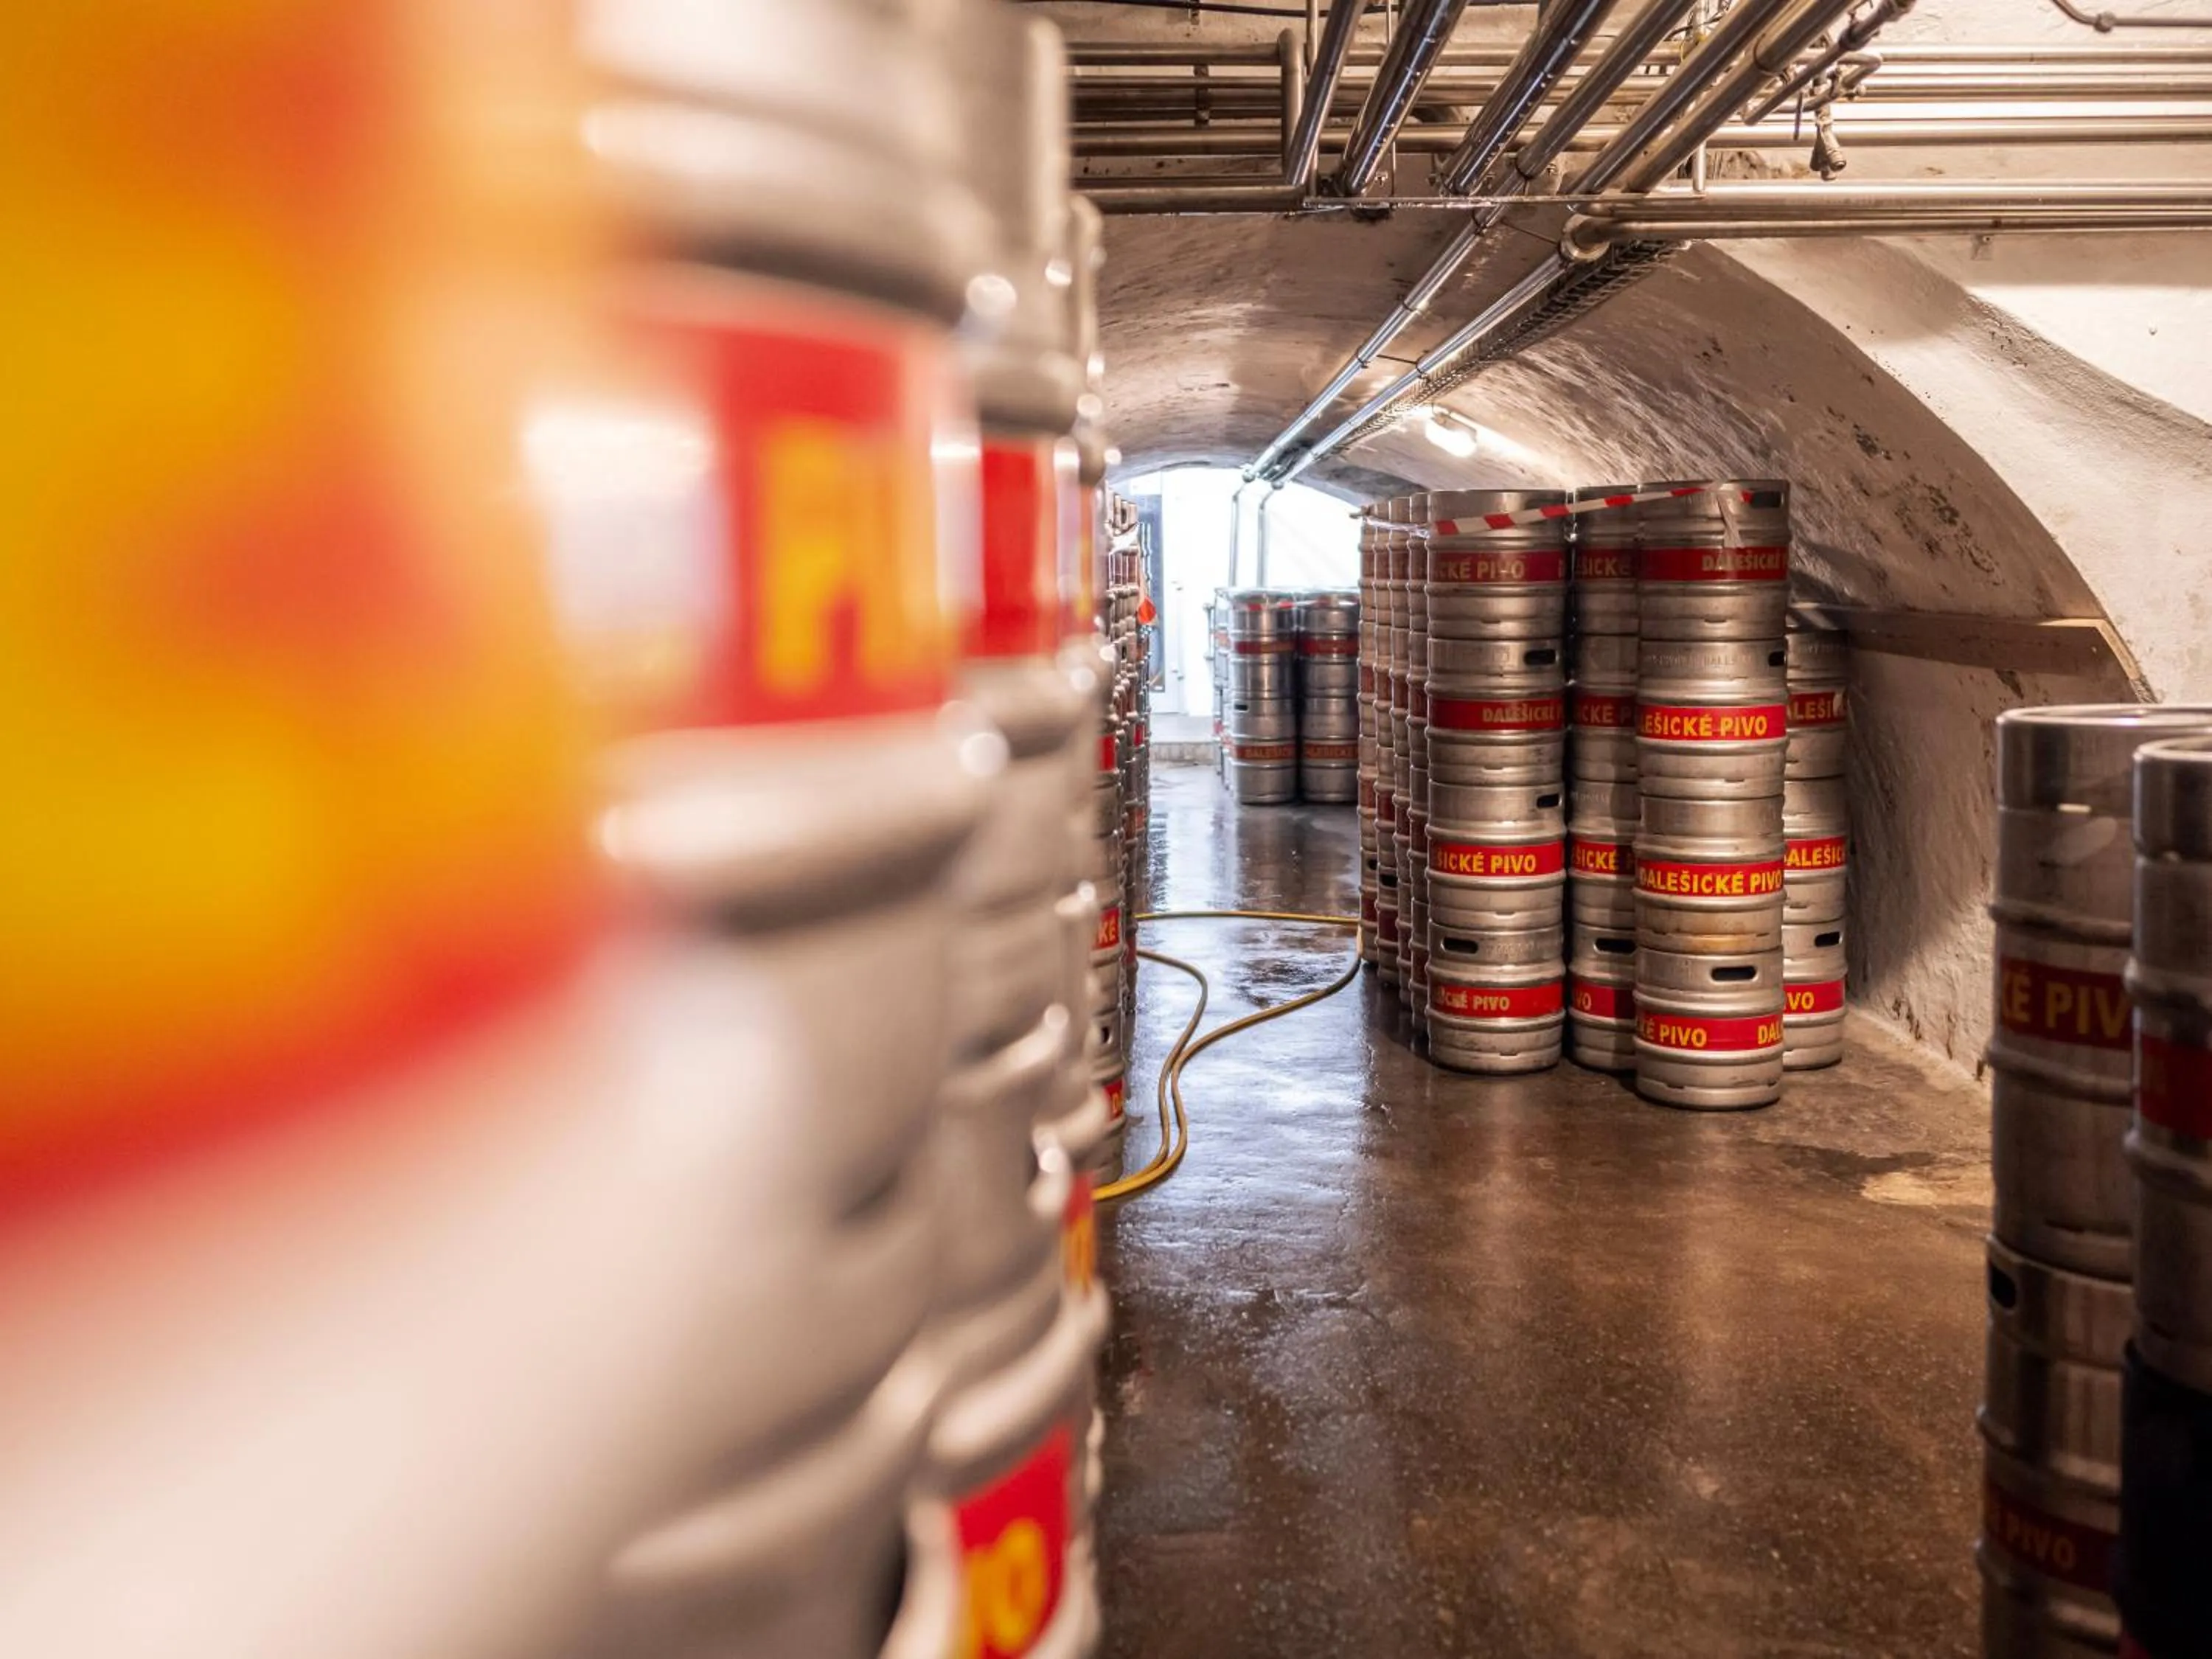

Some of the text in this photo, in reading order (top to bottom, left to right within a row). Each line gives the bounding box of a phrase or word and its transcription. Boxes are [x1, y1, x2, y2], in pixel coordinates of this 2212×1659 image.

[1720, 715, 1767, 737] PIVO
[1490, 854, 1537, 874] PIVO
[1784, 844, 1845, 867] ALEŠIC
[1639, 866, 1782, 894] DALEŠICKÉ PIVO
[1473, 995, 1510, 1012] PIVO
[1784, 991, 1815, 1012] VO
[1660, 1023, 1707, 1048] PIVO
